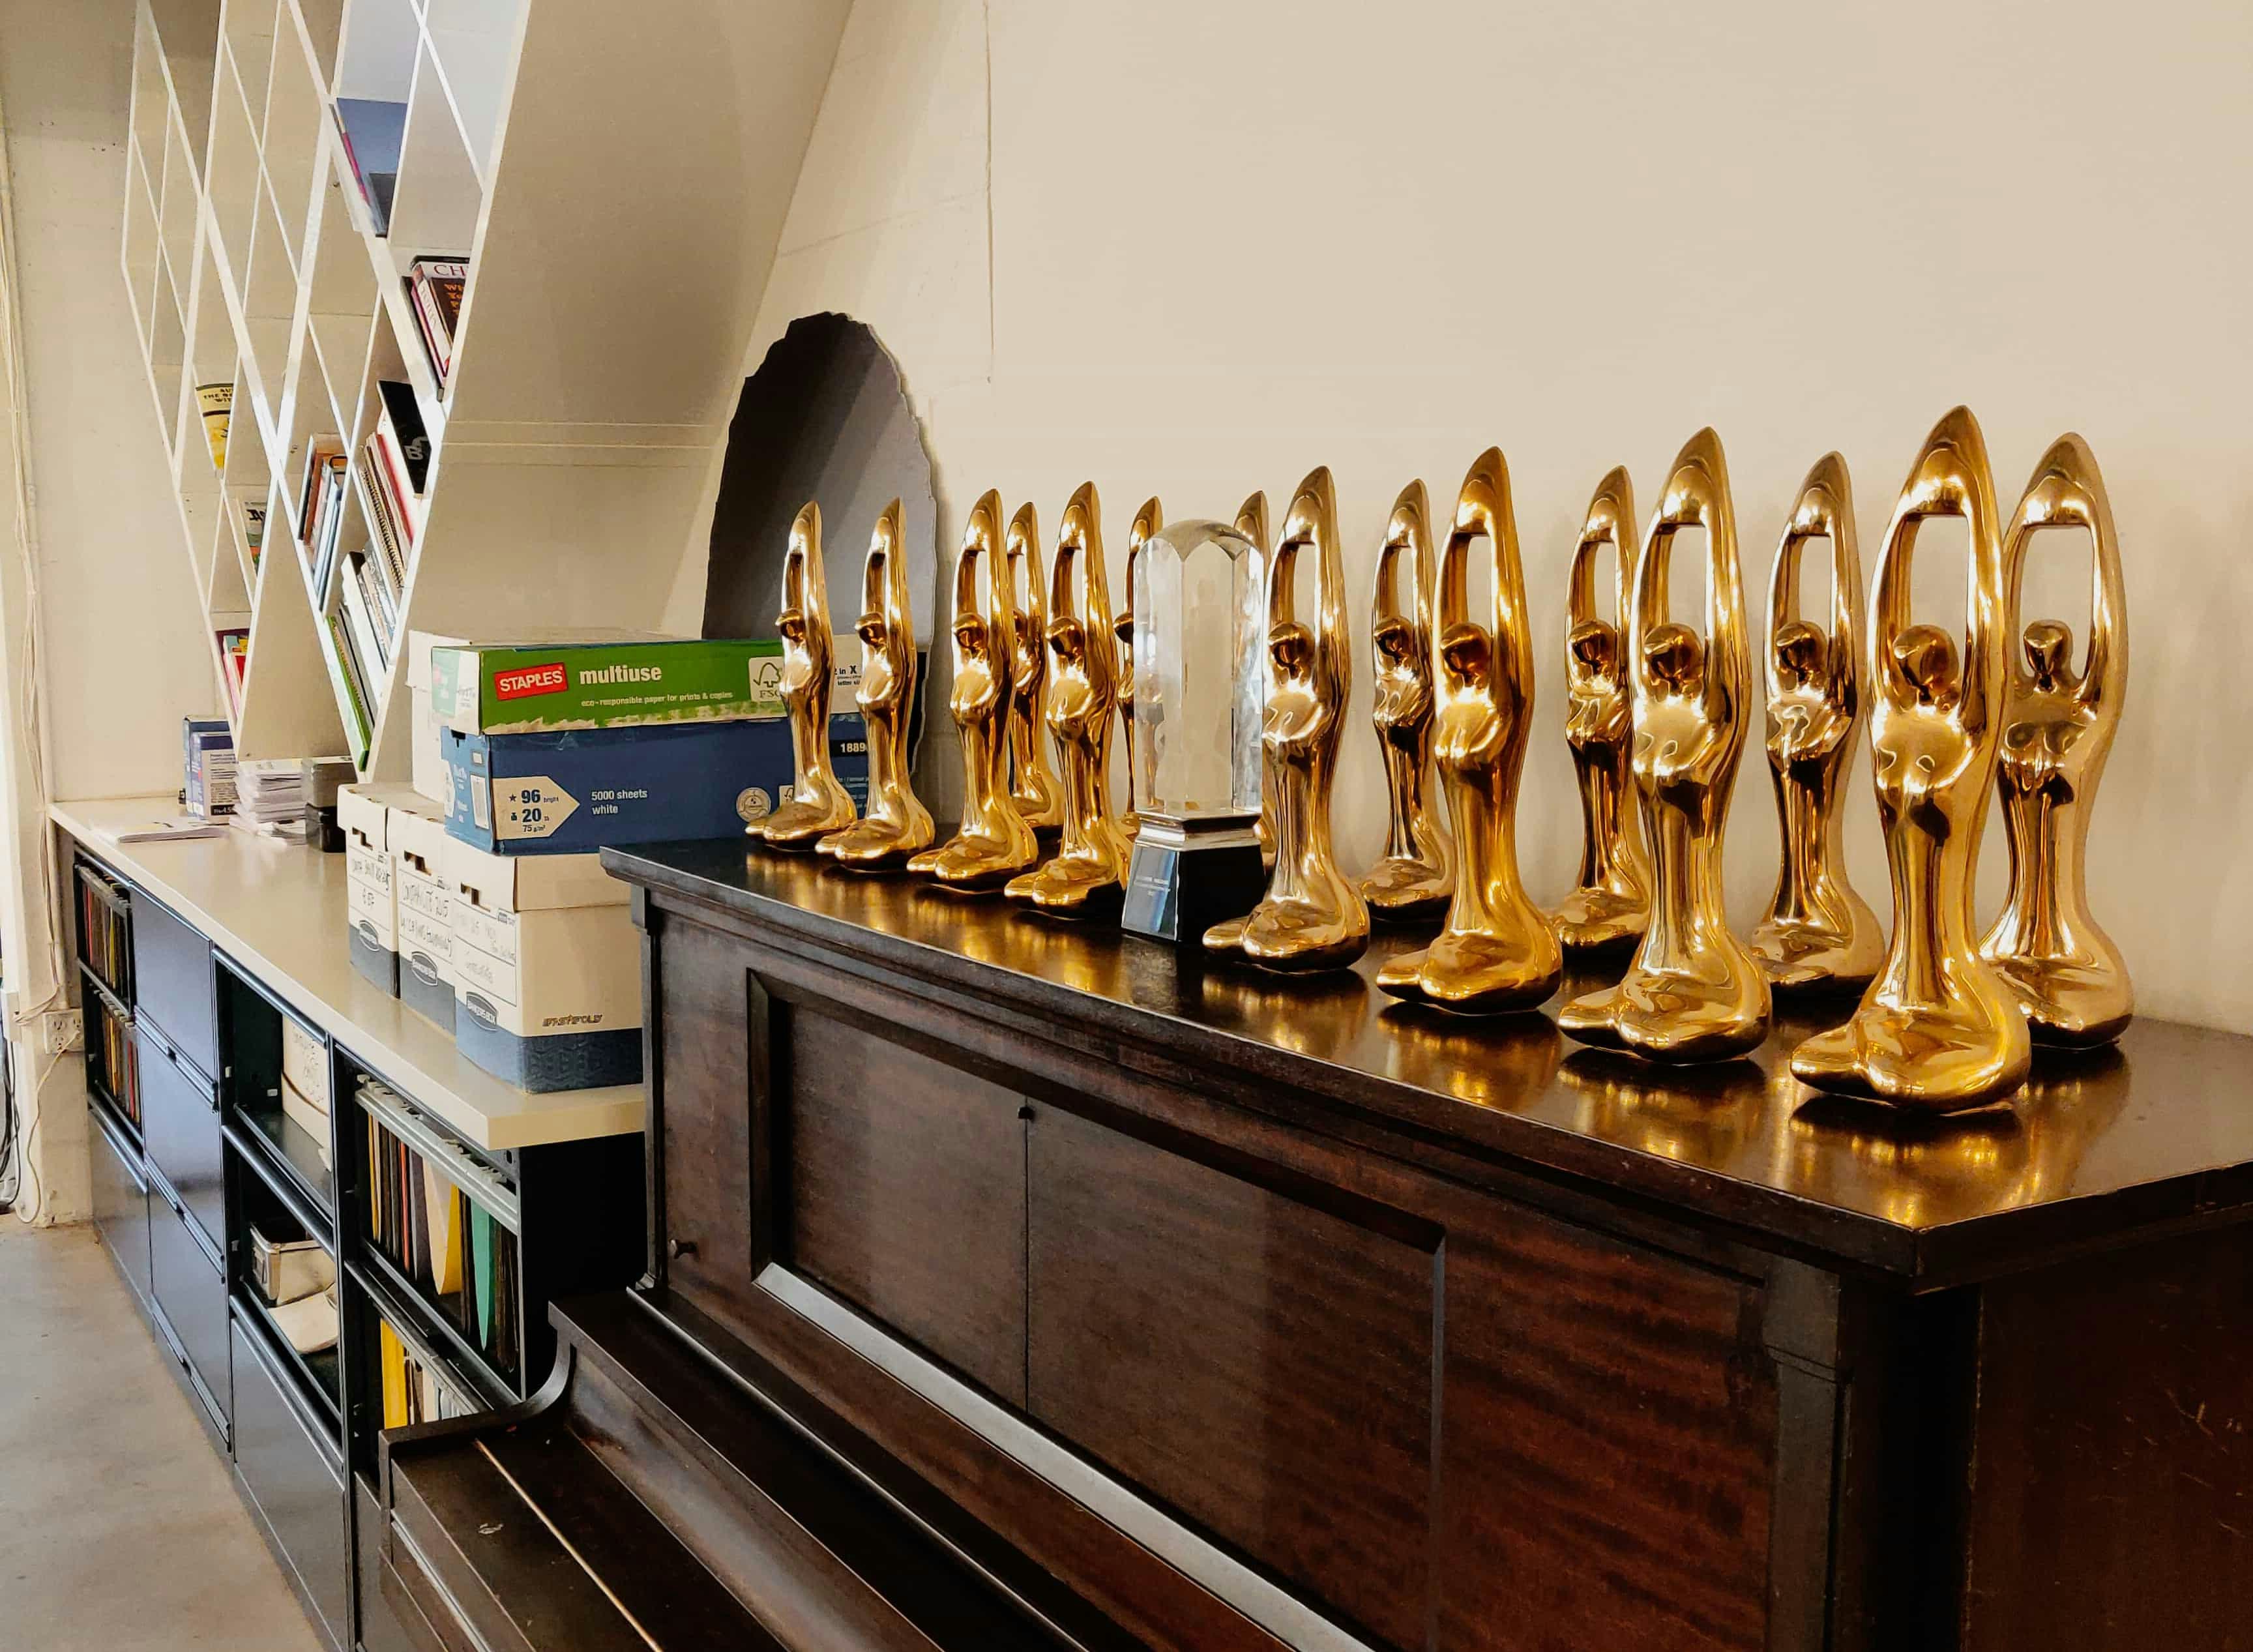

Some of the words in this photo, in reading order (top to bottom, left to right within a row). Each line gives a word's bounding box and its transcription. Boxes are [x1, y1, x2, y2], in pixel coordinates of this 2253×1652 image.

[434, 264, 469, 276] CH
[499, 670, 563, 692] STAPLES
[579, 665, 662, 685] multiuse
[644, 696, 666, 705] paper
[679, 692, 701, 702] prints
[709, 691, 733, 700] copies
[840, 742, 867, 753] 1889
[522, 789, 540, 803] 96
[591, 789, 615, 801] 5000
[617, 788, 648, 799] sheets
[522, 808, 542, 822] 20
[592, 804, 619, 815] white
[523, 824, 532, 833] 75
